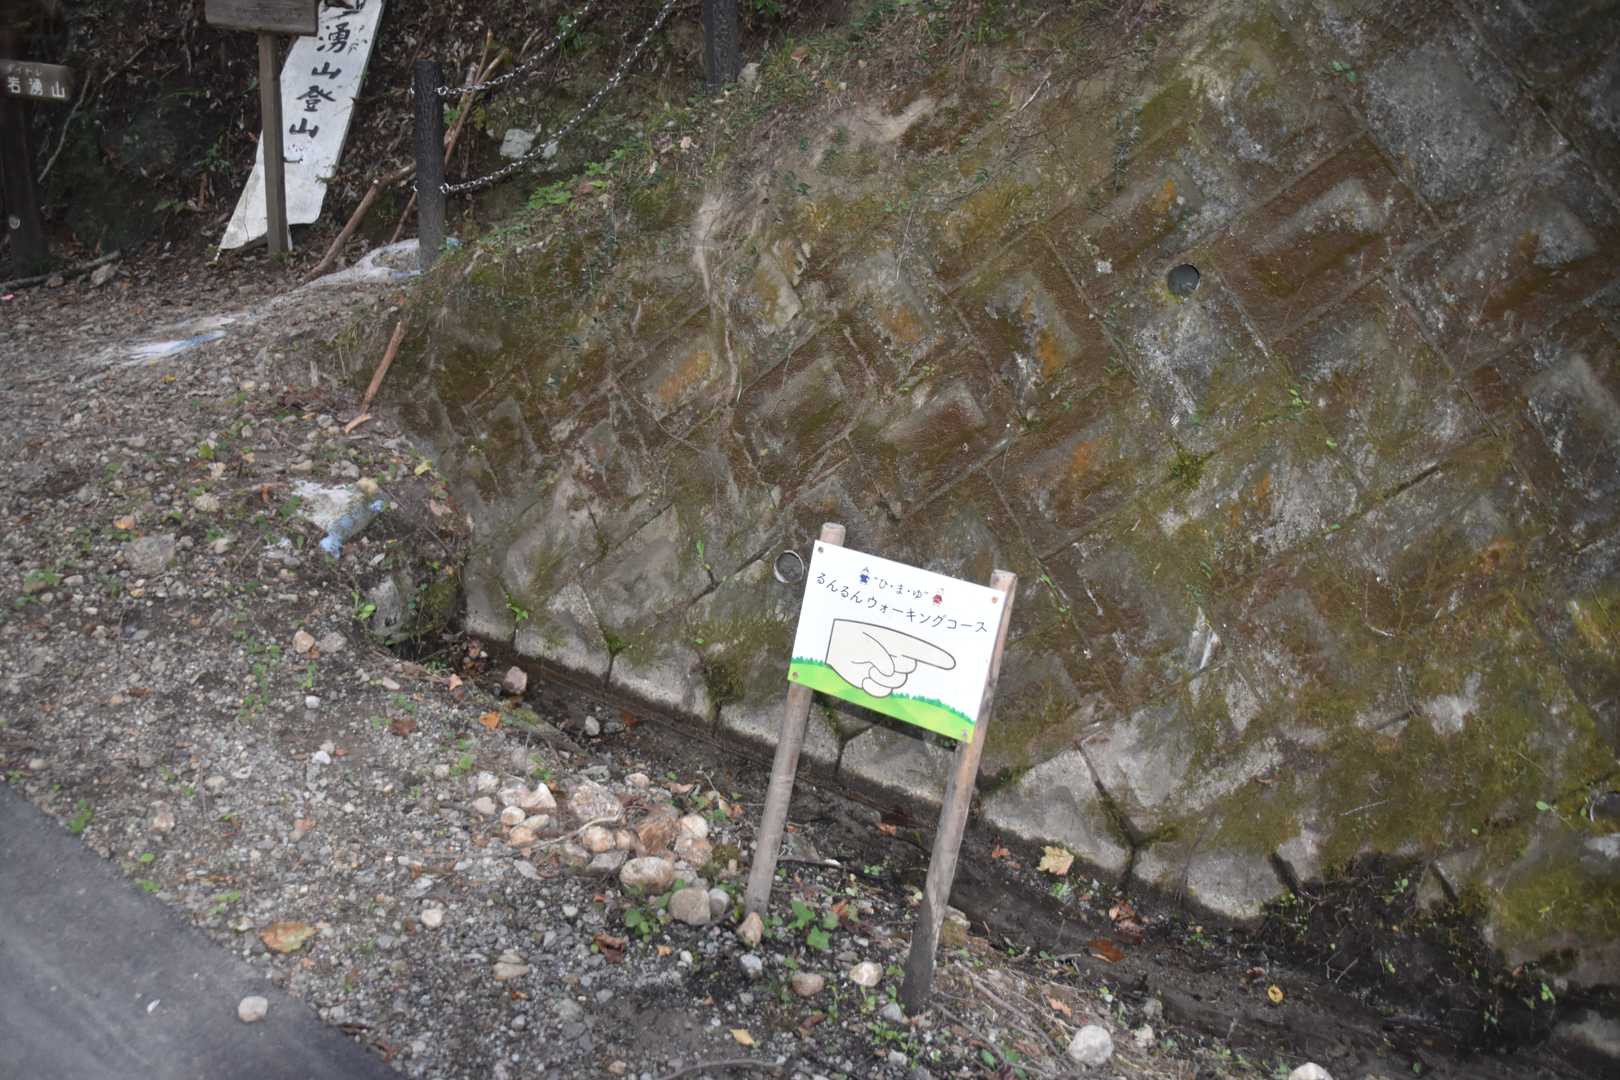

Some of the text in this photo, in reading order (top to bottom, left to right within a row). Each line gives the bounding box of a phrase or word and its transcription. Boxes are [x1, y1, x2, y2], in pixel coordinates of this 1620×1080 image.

[816, 573, 988, 633] るんるんウォーキングコース
